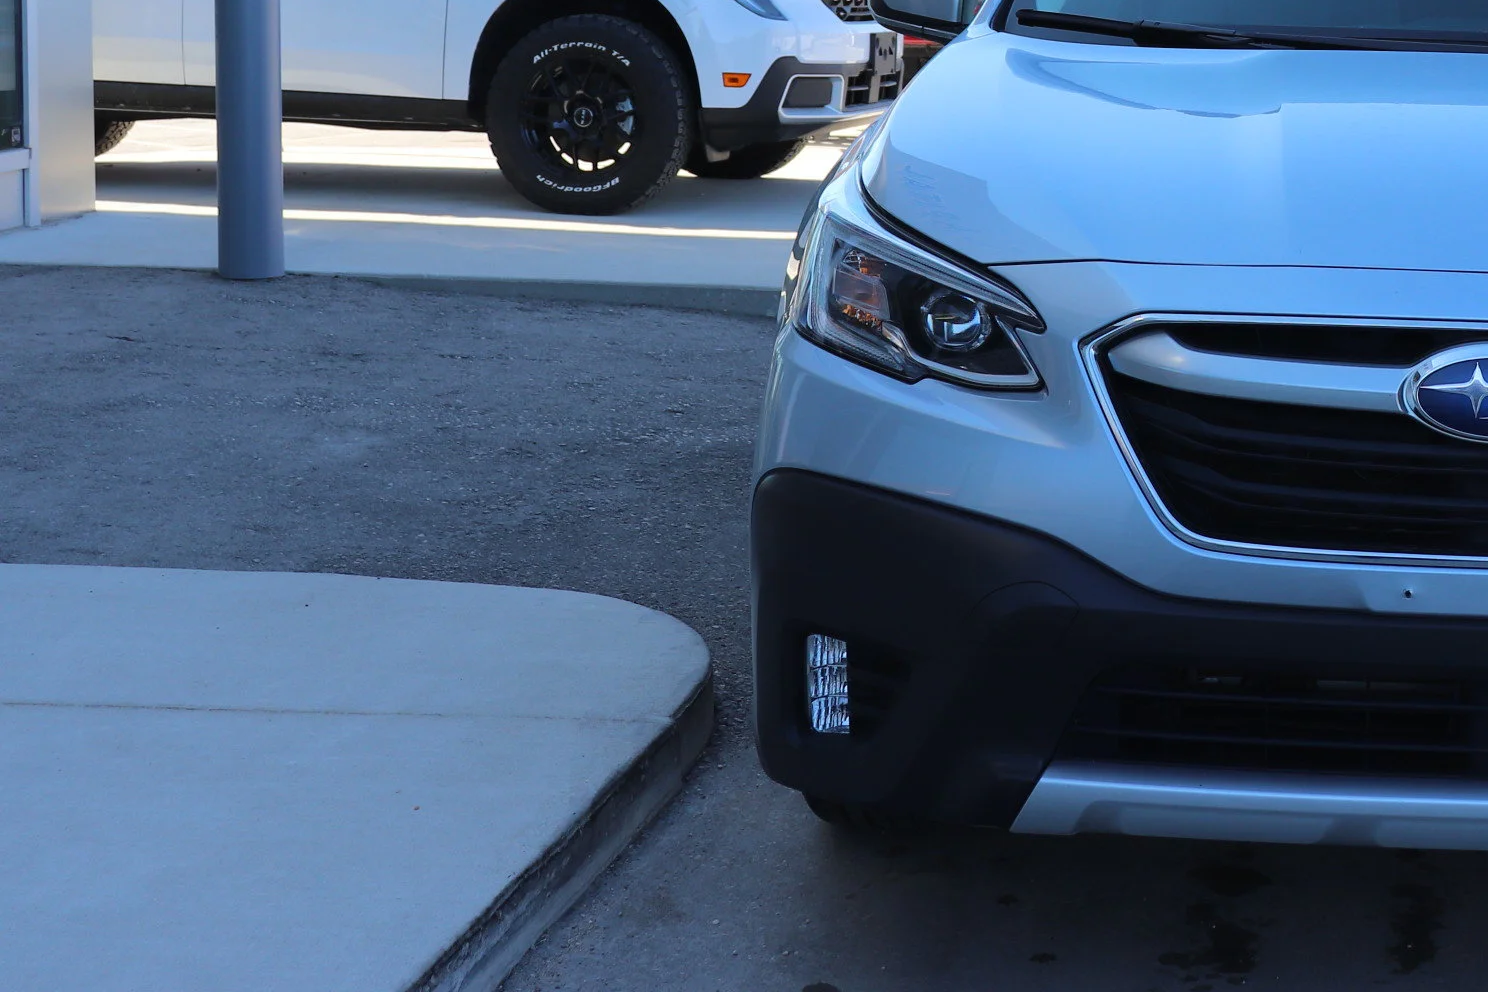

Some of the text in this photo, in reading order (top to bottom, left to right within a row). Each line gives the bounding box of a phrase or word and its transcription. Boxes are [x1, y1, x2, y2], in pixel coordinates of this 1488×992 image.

[533, 41, 630, 67] All-Terrain T/A
[536, 174, 620, 193] BFGoodrich
